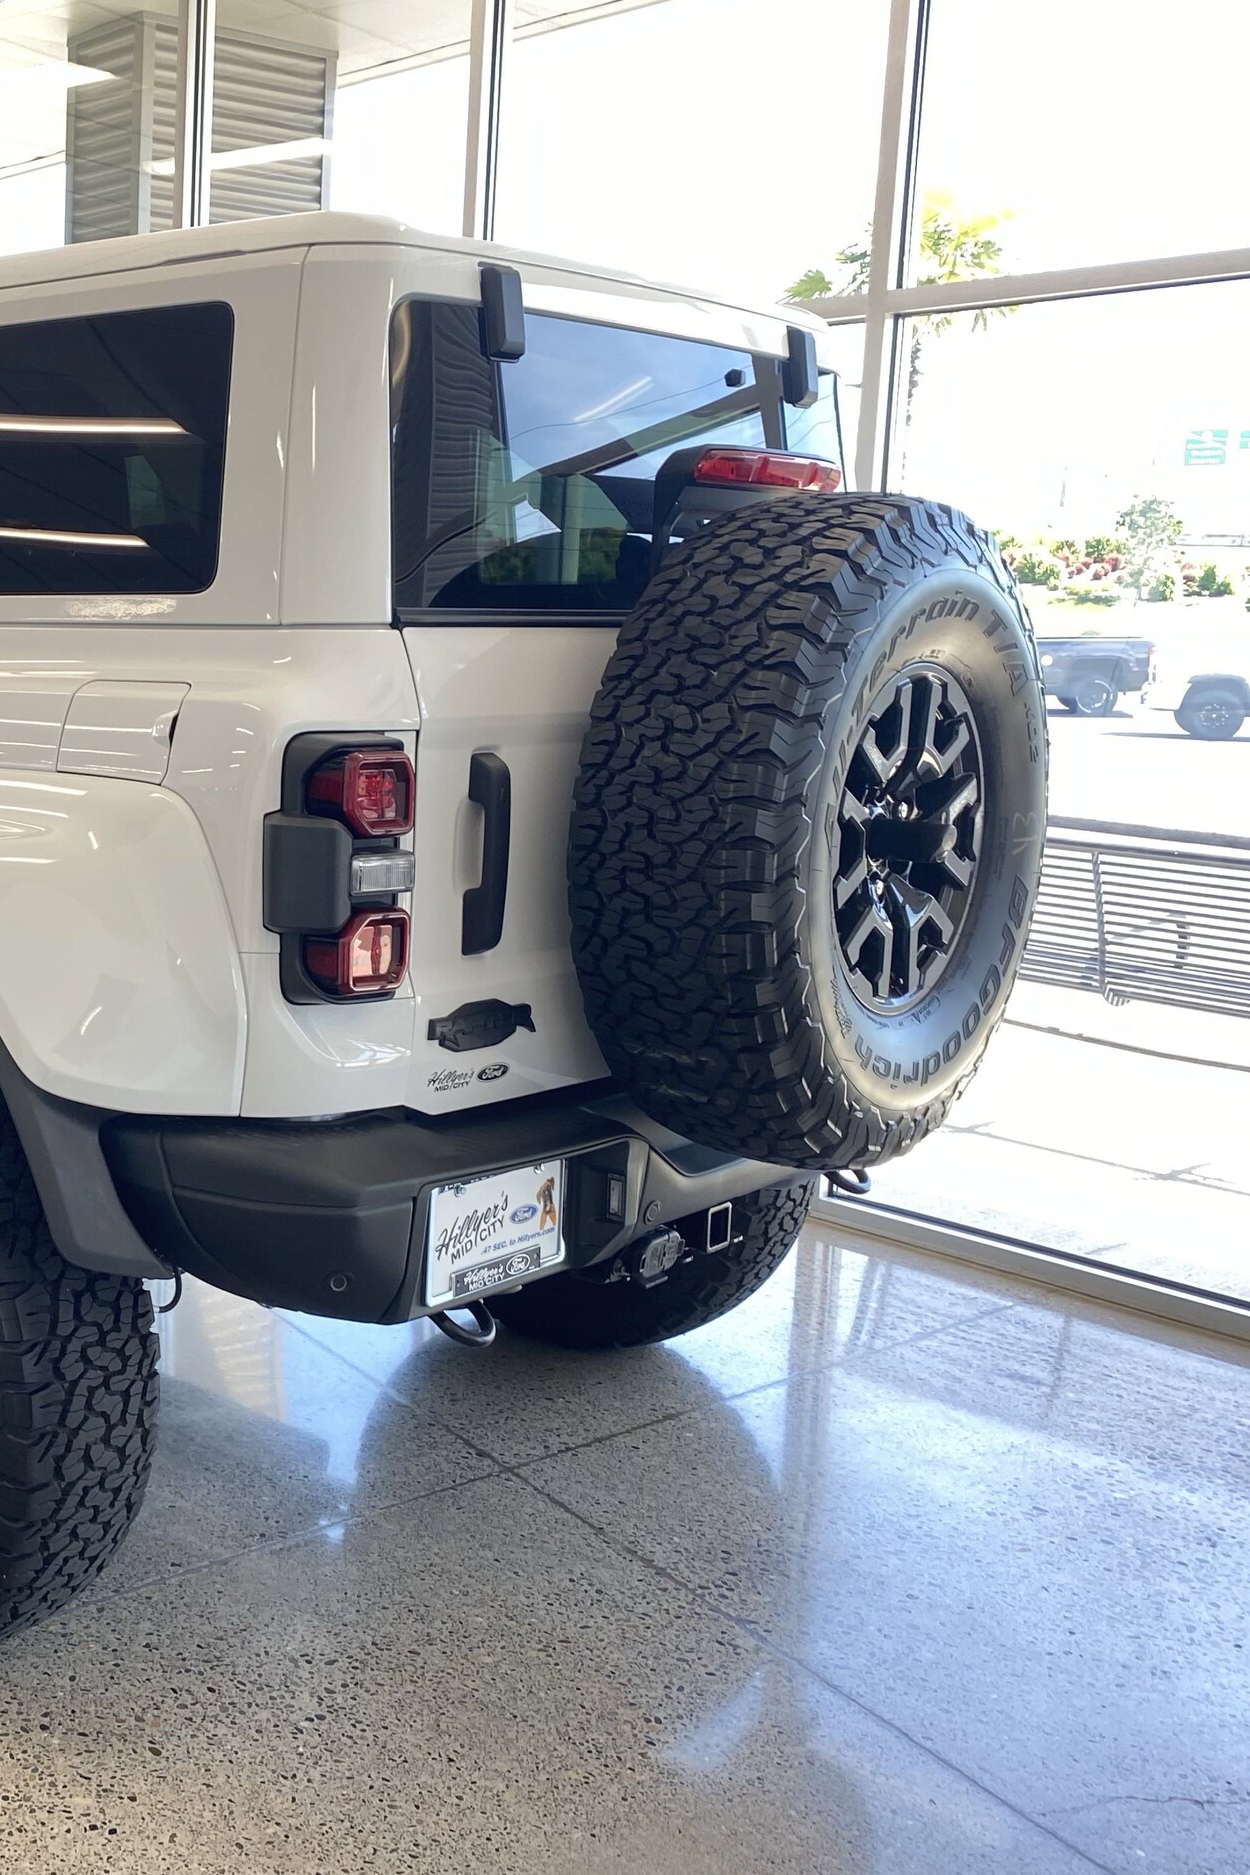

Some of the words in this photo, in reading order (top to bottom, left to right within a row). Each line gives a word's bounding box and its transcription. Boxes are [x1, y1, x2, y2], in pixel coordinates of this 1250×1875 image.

[854, 873, 1029, 1087] BFGoodrich
[427, 1067, 475, 1087] Hillyer's
[479, 1063, 508, 1081] Ford
[434, 1083, 450, 1093] MID
[452, 1080, 471, 1090] CITY
[435, 1190, 509, 1261] Hillyer's
[512, 1206, 536, 1222] Ford
[509, 1238, 517, 1247] to
[517, 1227, 556, 1244] Hillyers.com
[450, 1239, 473, 1264] MID
[479, 1215, 505, 1240] CITY
[463, 1264, 504, 1285] Hillyer's
[508, 1255, 528, 1273] Ford
[469, 1280, 485, 1292] MID
[485, 1273, 505, 1286] CITY
